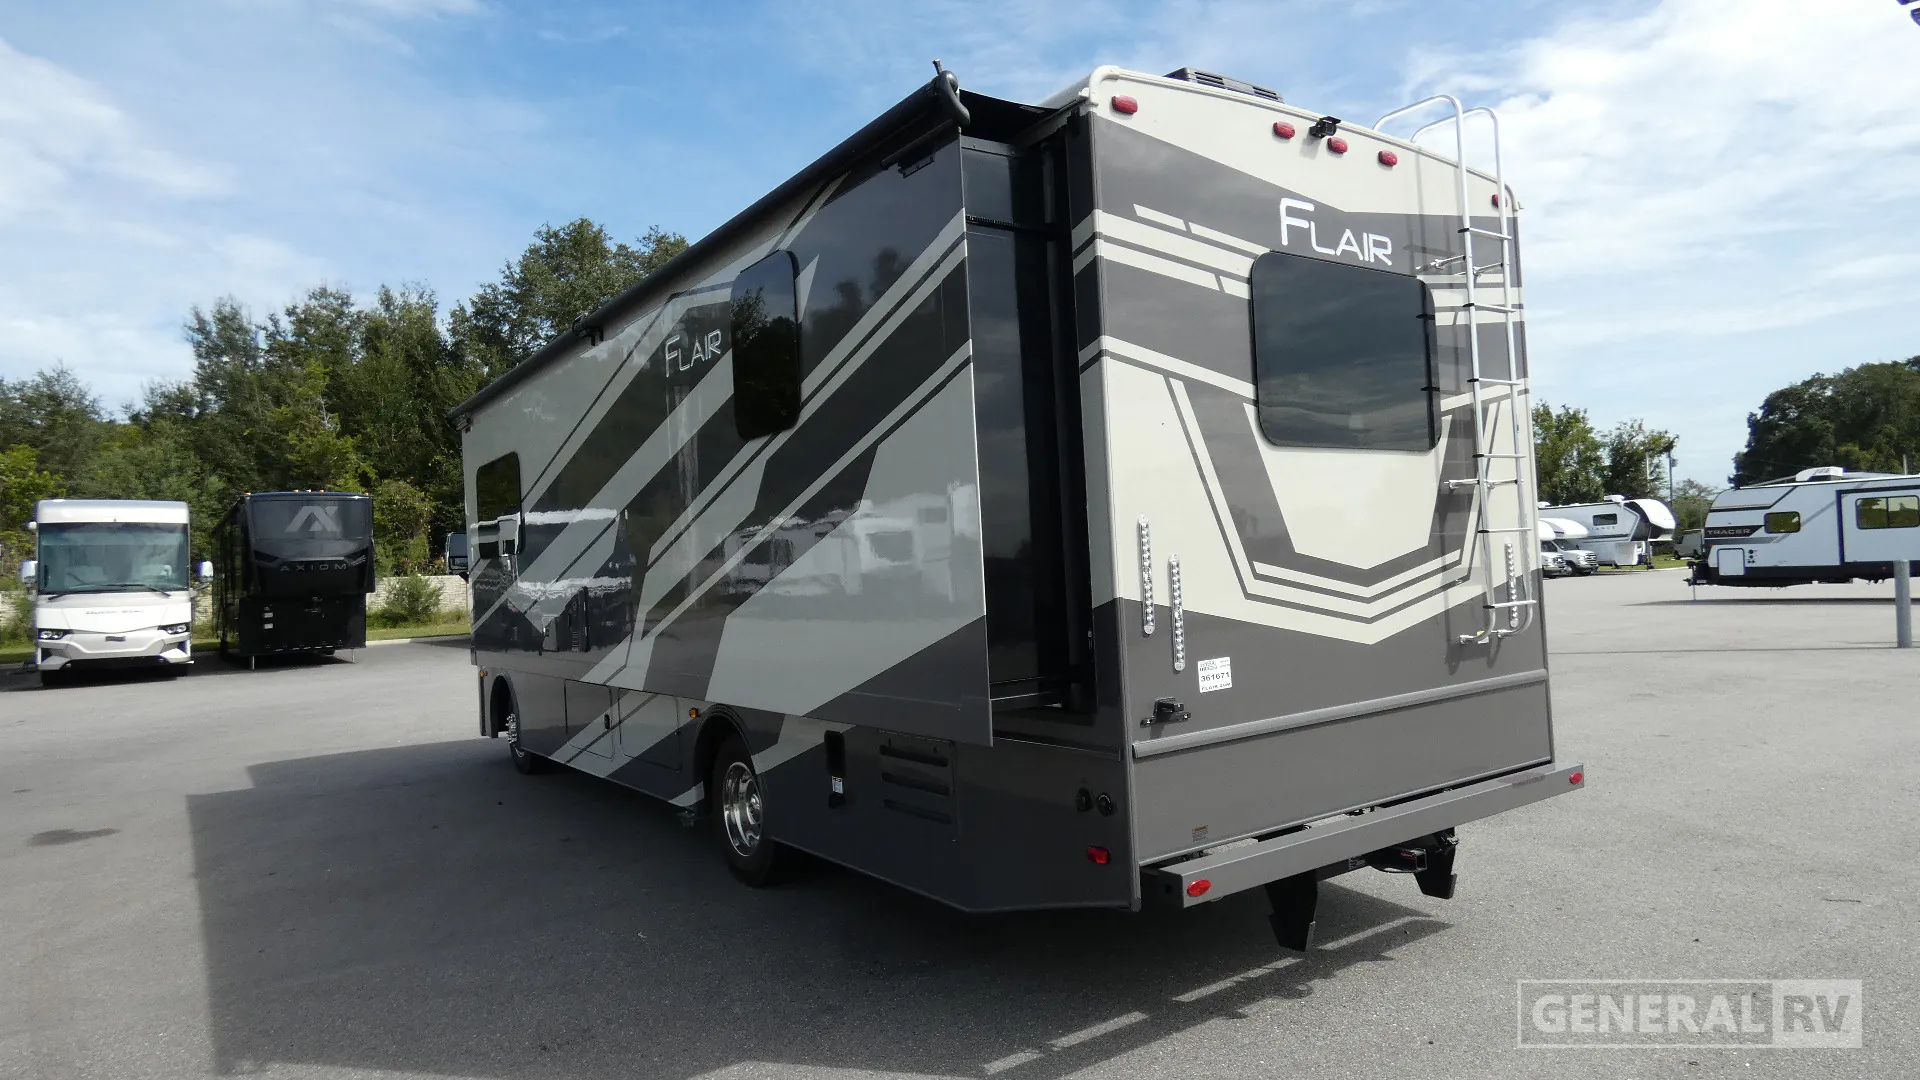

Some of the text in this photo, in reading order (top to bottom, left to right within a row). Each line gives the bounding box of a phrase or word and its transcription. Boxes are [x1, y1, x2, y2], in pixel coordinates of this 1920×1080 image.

[1279, 197, 1392, 265] FLAIR
[665, 328, 721, 377] FLAIR
[280, 563, 347, 571] AXIOM
[1201, 672, 1230, 682] 361671
